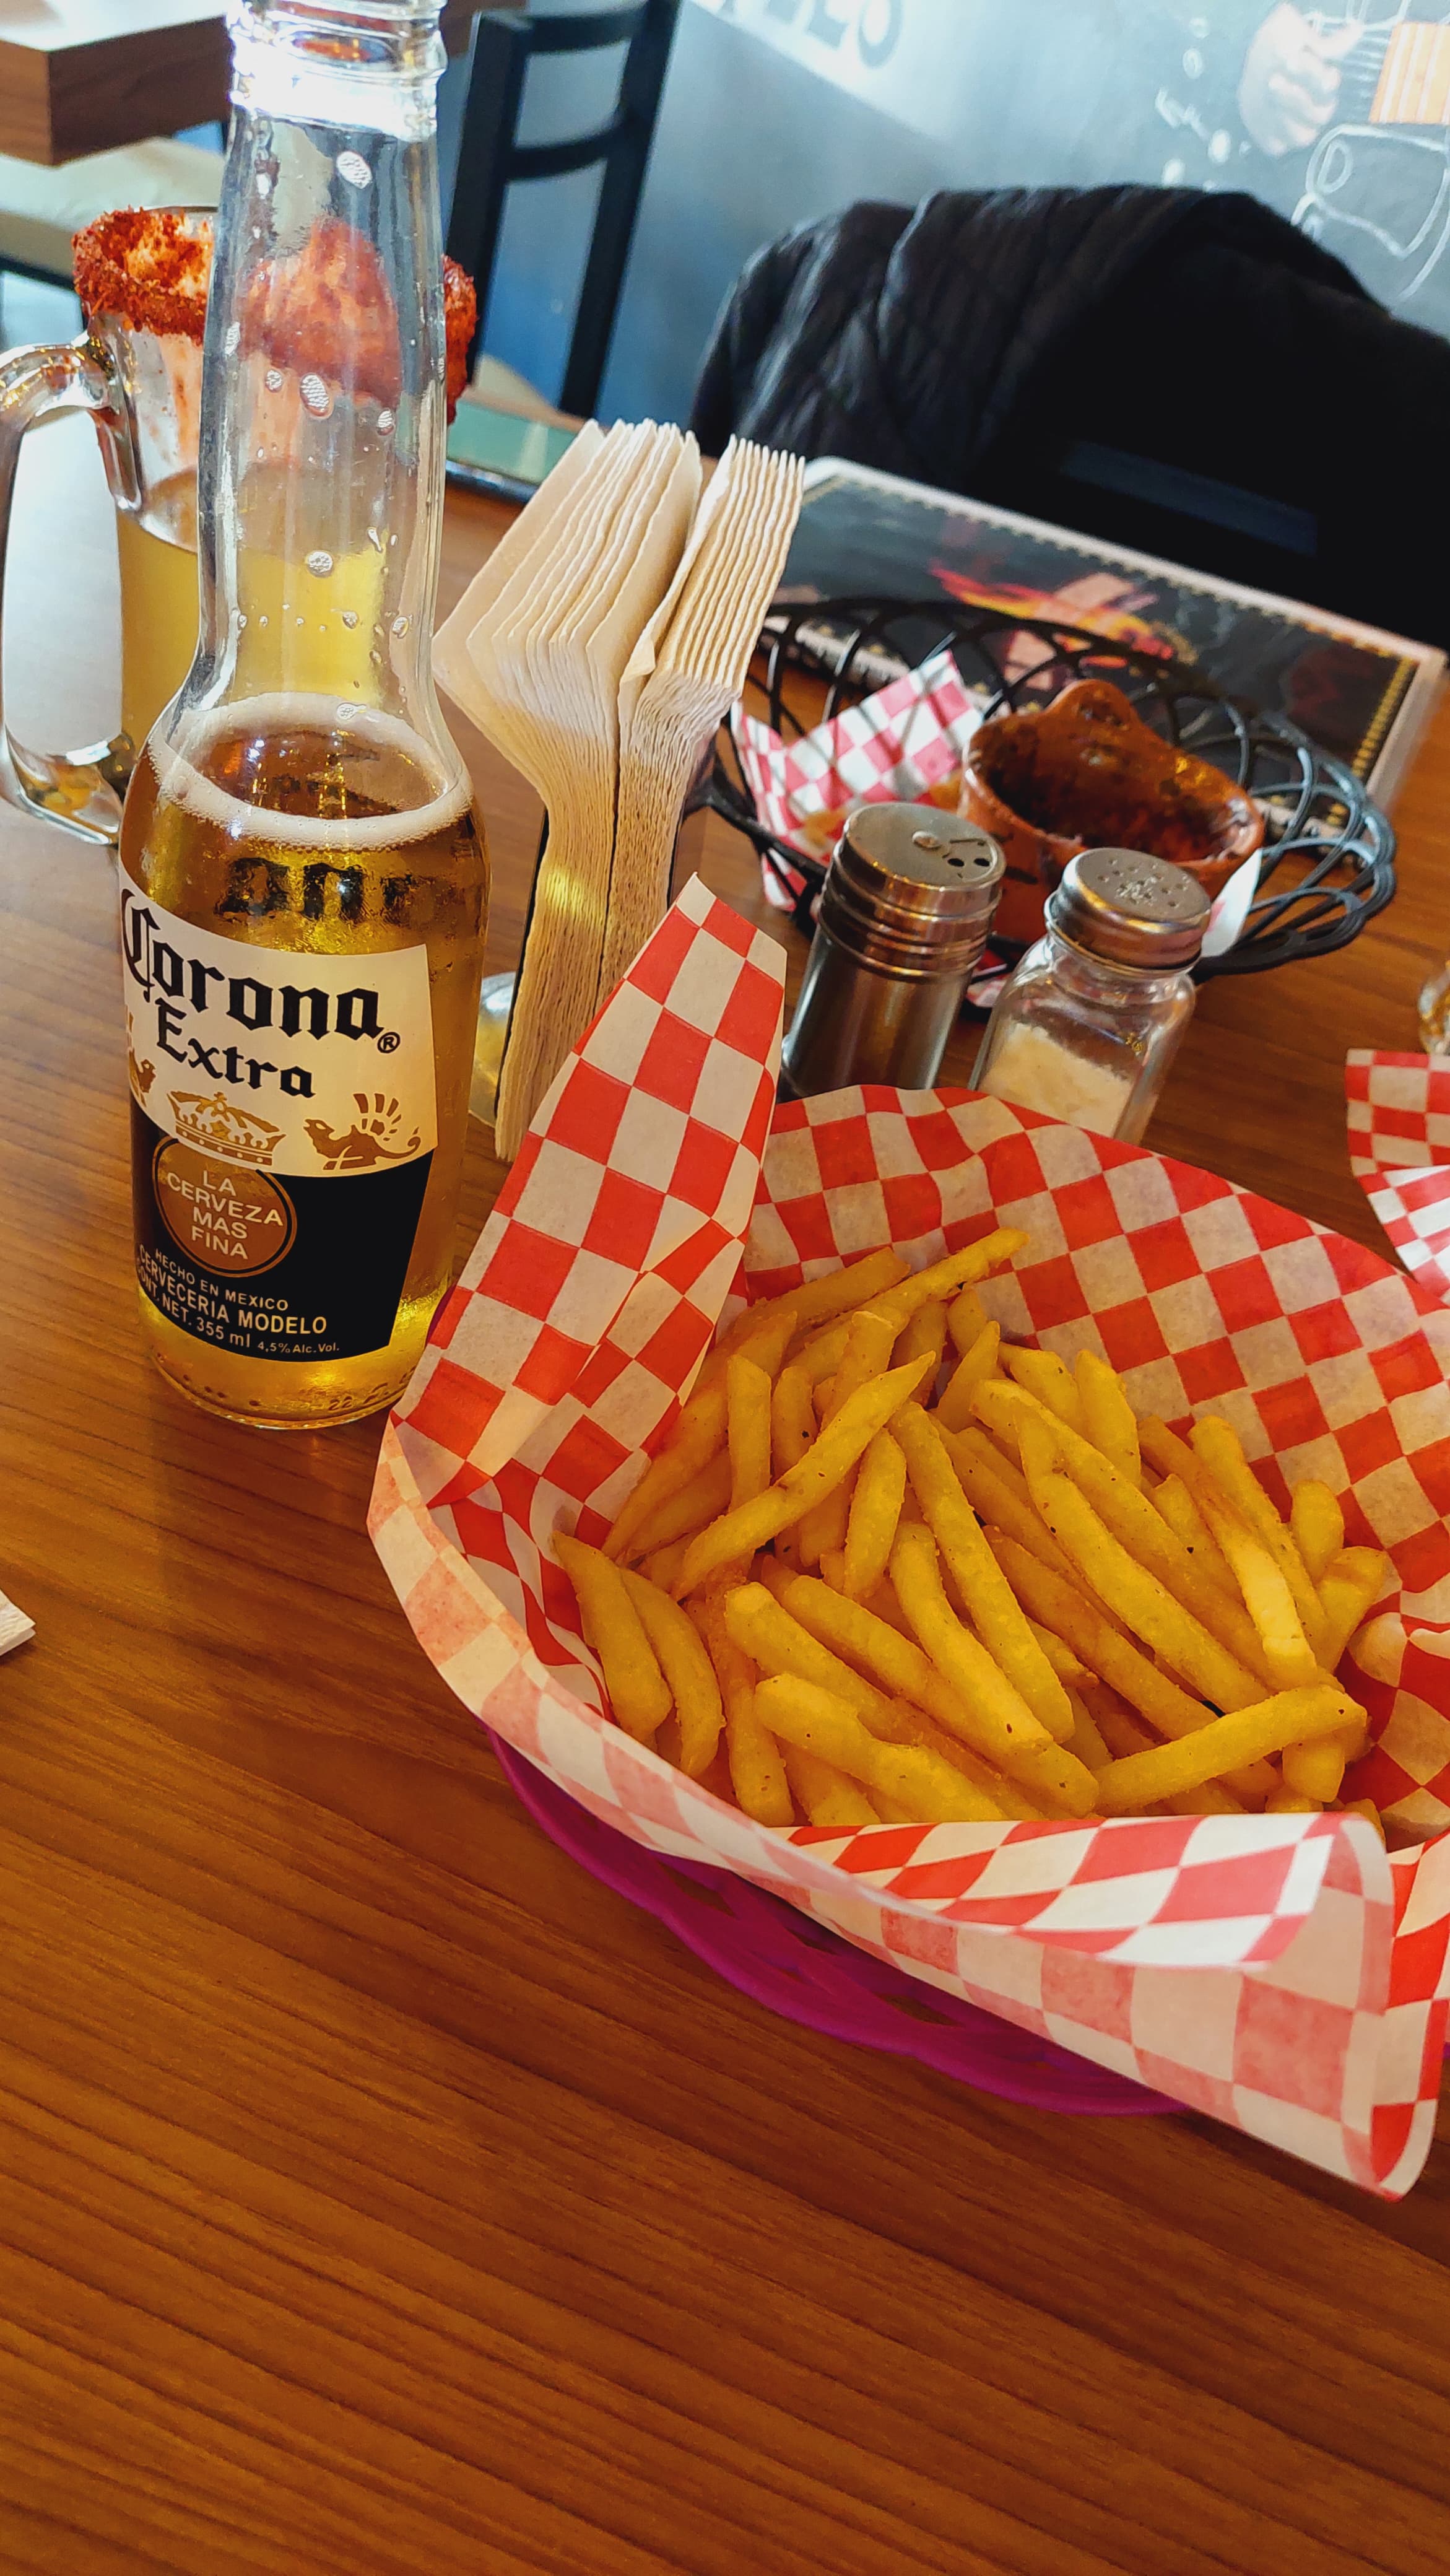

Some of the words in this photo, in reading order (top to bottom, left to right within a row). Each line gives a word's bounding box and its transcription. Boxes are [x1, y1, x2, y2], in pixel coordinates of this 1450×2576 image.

[155, 998, 316, 1099] Extra
[167, 1172, 284, 1226] CERVEZA
[203, 1170, 237, 1196] LA
[192, 1225, 248, 1260] FINA
[193, 1206, 248, 1239] MAS
[139, 1244, 230, 1323] CERVECERIA
[238, 1309, 327, 1334] MODELO
[158, 1248, 196, 1285] HECHO
[201, 1279, 219, 1296] EN
[225, 1289, 289, 1311] MEXICO
[162, 1293, 192, 1326] NET.
[196, 1316, 224, 1340] 355
[230, 1333, 251, 1348] ml
